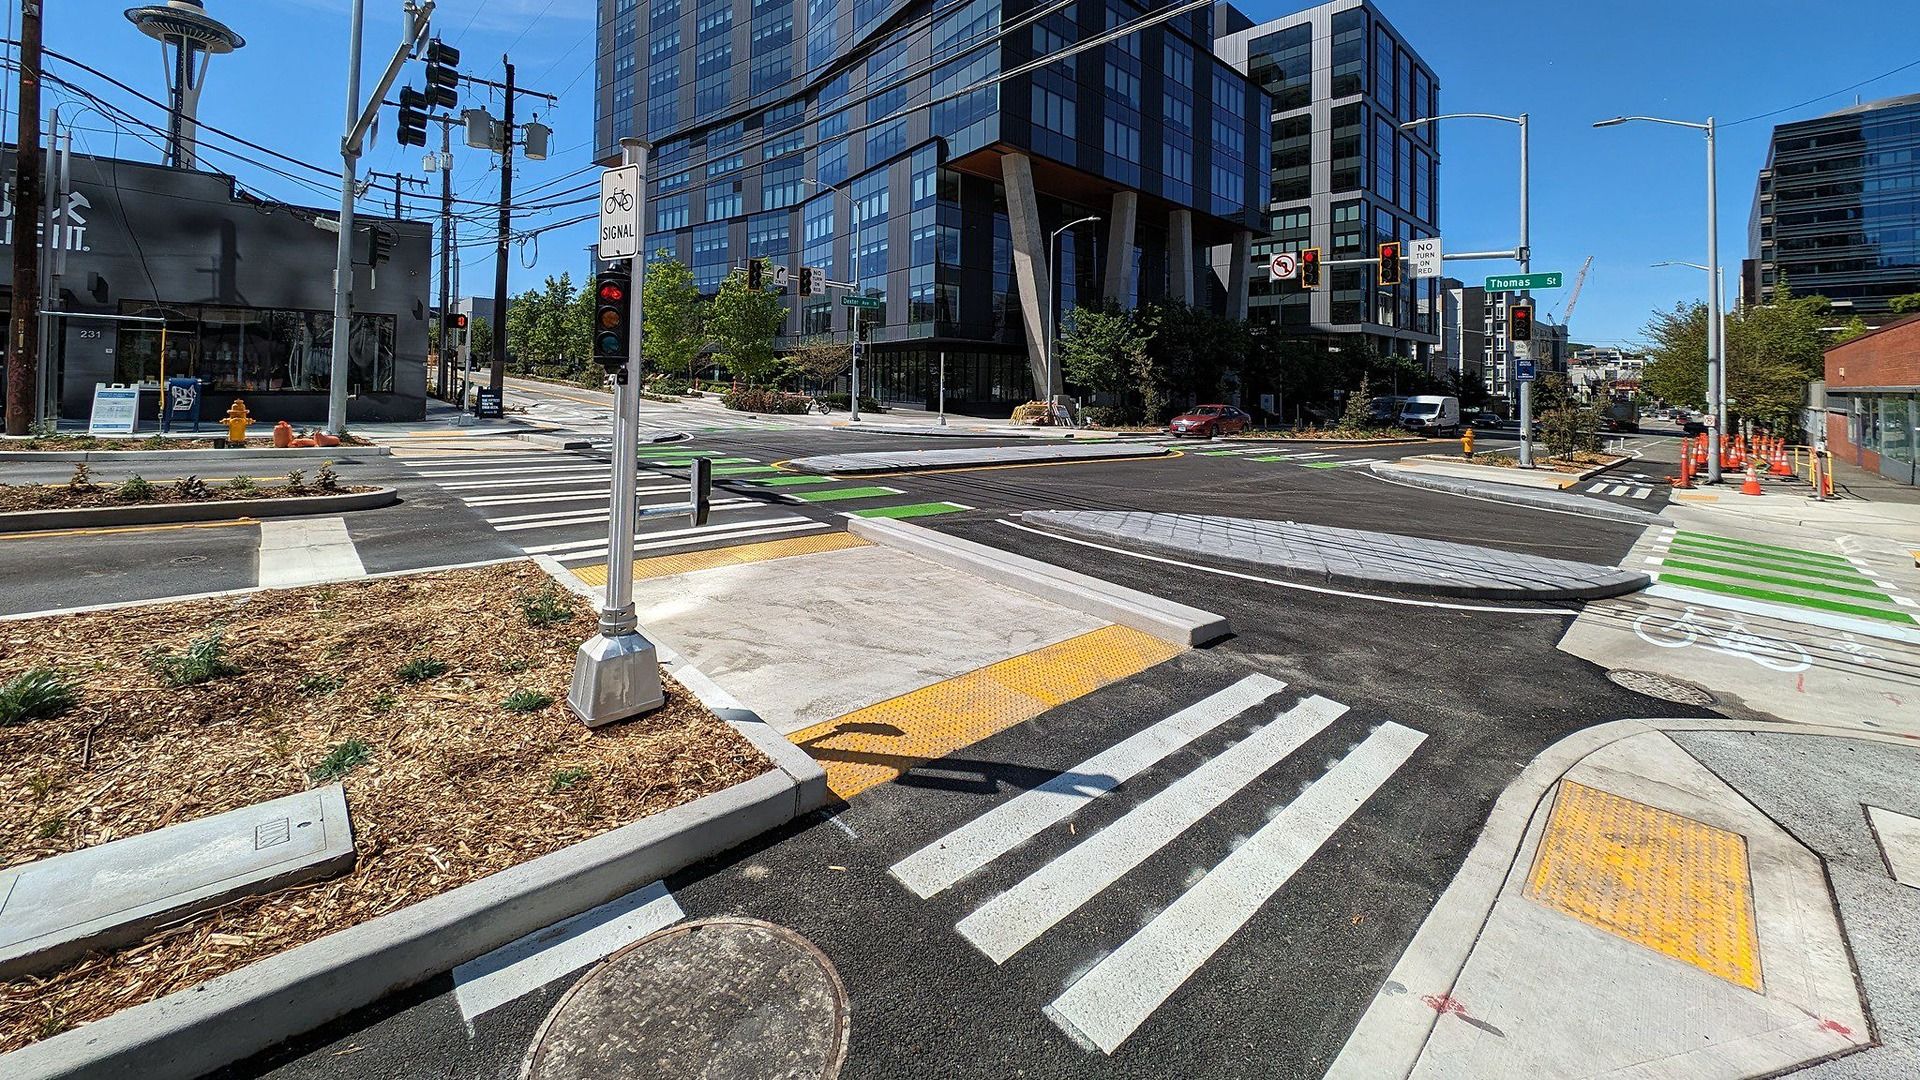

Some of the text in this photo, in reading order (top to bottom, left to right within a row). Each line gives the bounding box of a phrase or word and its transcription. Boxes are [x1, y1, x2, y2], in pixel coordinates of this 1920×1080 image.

[603, 224, 634, 240] SIGNAL
[1417, 243, 1433, 251] NO
[1490, 277, 1556, 288] Thomas St
[843, 297, 859, 305] Dexter
[80, 330, 101, 338] 231
